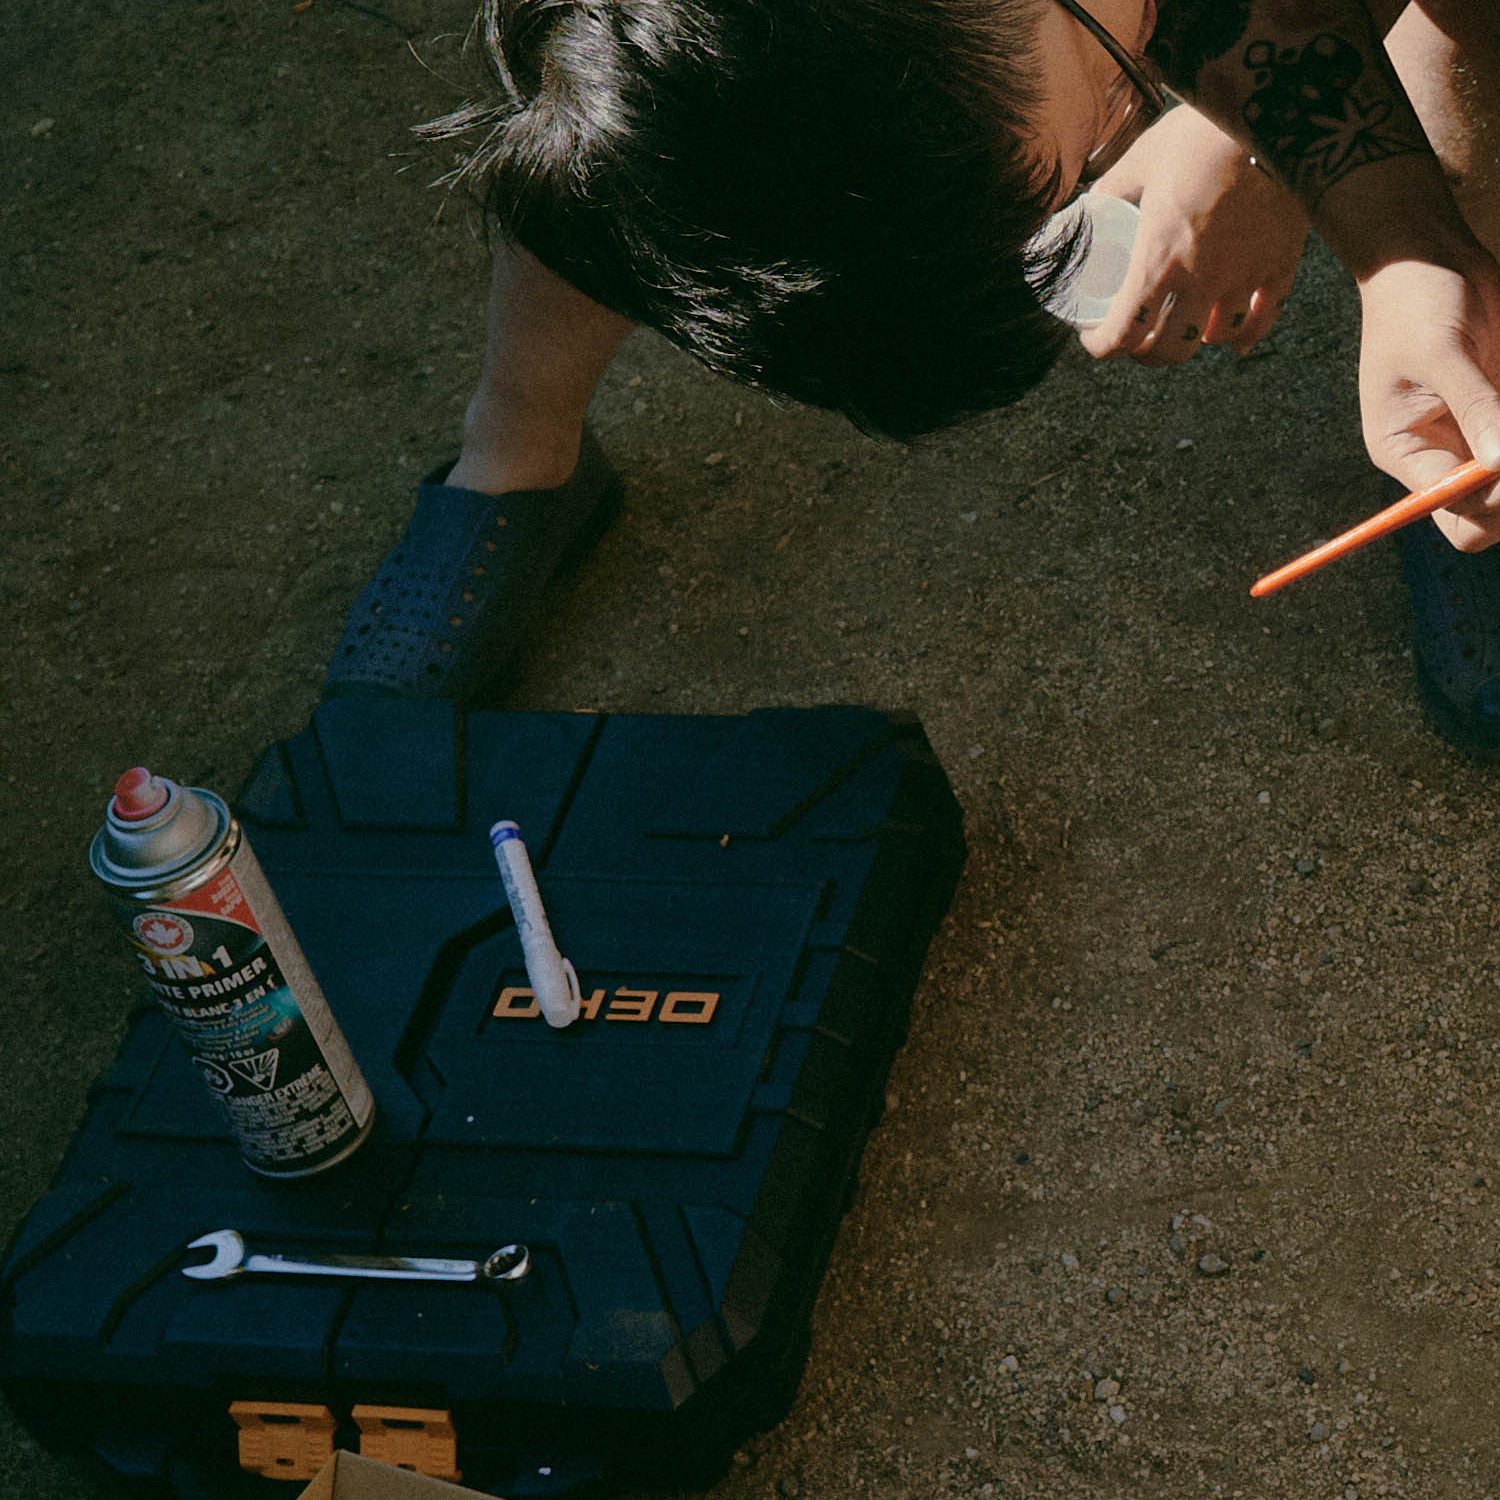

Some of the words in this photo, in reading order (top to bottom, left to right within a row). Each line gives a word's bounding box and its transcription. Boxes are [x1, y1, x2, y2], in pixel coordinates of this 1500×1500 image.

[160, 955, 207, 980] IN
[212, 945, 233, 969] 1
[188, 956, 268, 1000] PRIMER
